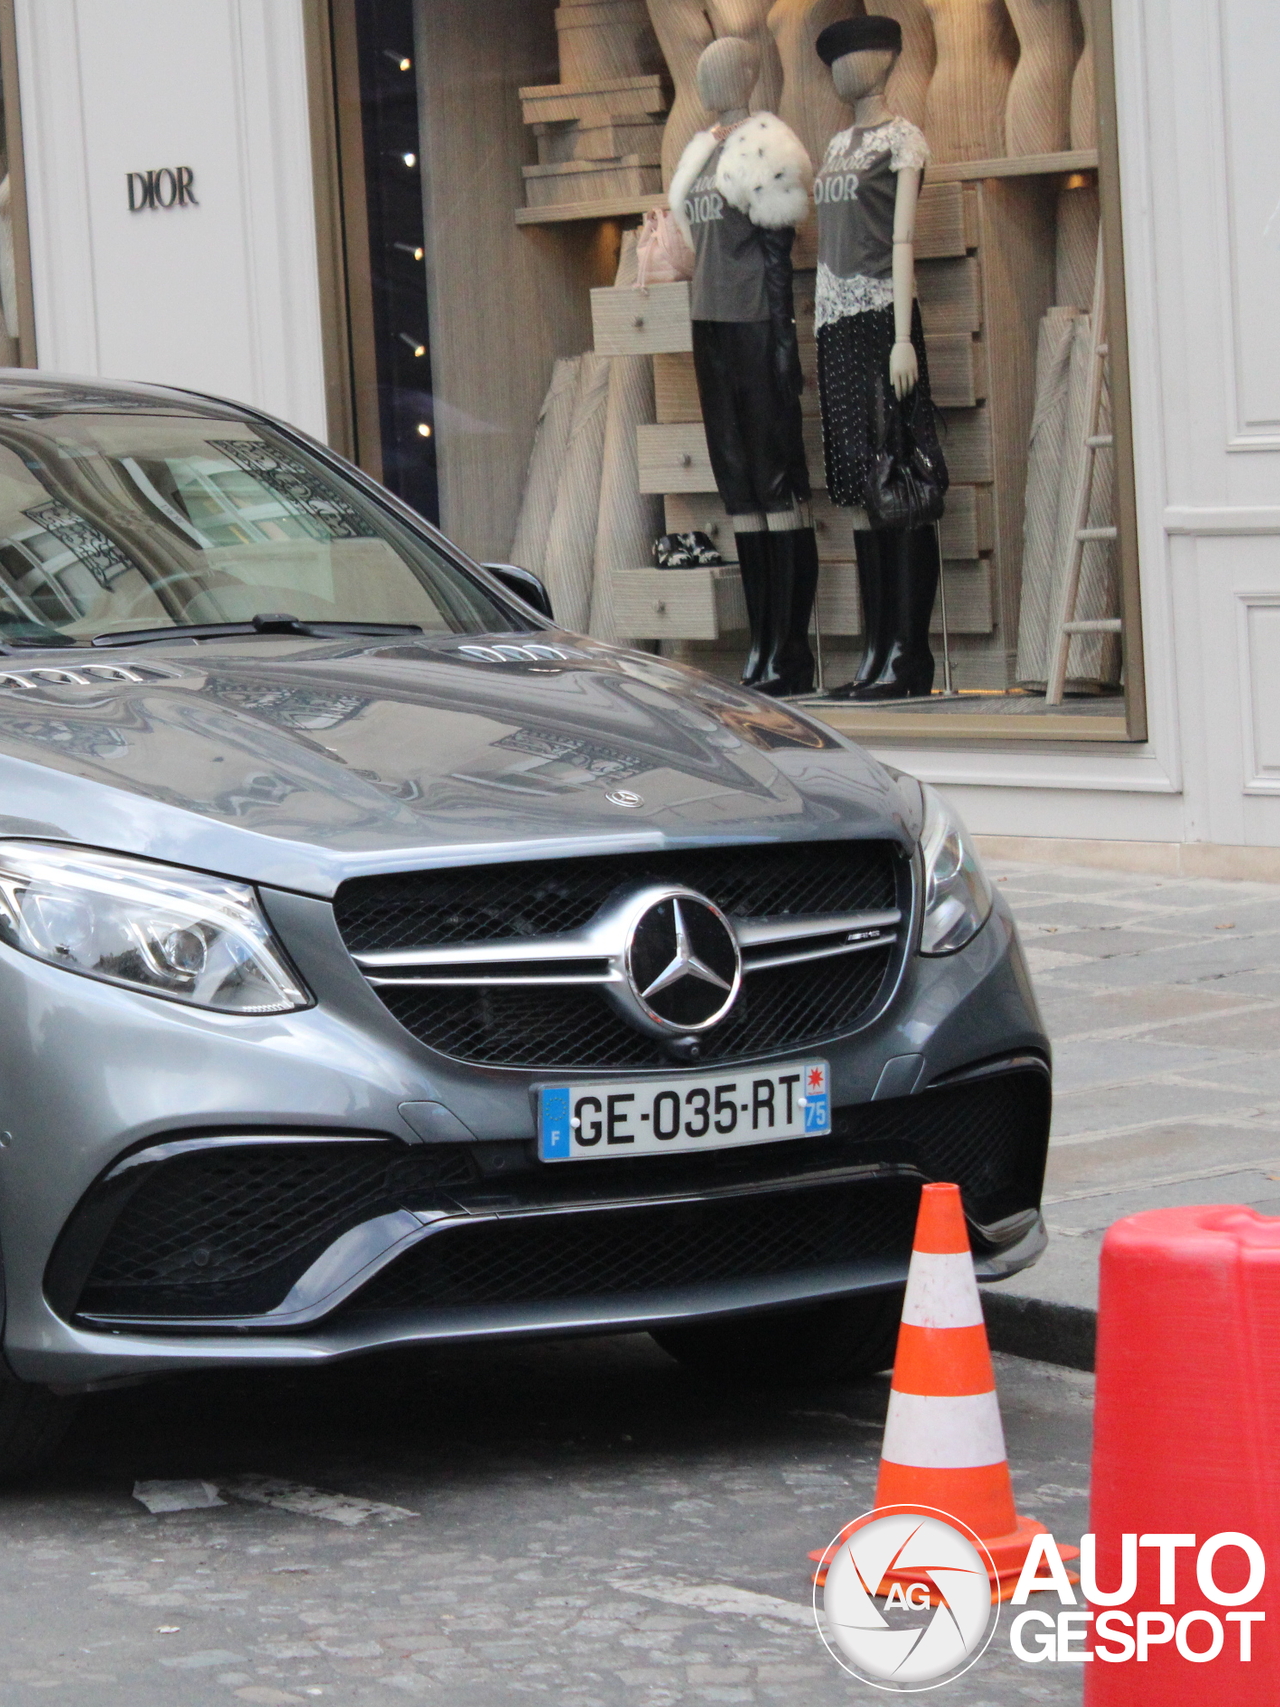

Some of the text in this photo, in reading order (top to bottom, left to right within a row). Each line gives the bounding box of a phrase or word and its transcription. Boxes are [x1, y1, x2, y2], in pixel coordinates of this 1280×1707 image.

[124, 166, 199, 212] DIOR
[813, 173, 859, 205] DIOR
[574, 1073, 801, 1147] GE-035-RT
[805, 1101, 826, 1127] 75
[550, 1130, 560, 1146] F
